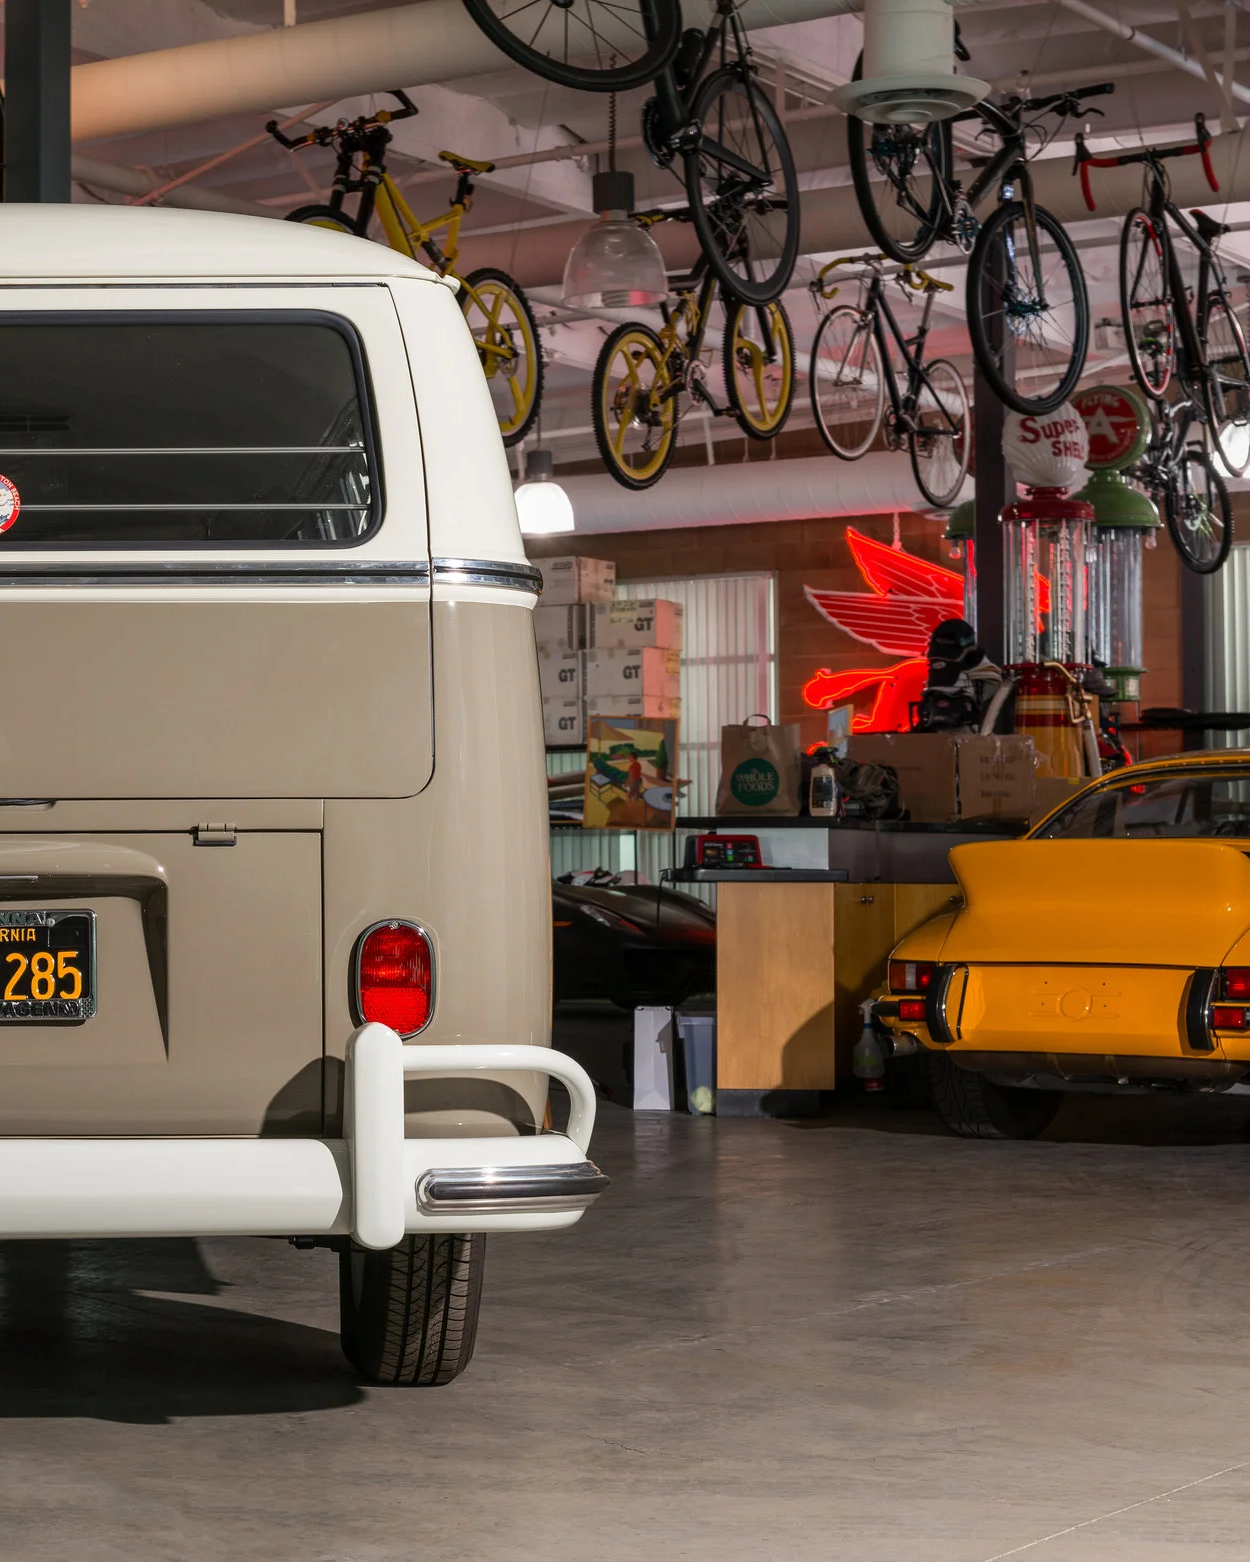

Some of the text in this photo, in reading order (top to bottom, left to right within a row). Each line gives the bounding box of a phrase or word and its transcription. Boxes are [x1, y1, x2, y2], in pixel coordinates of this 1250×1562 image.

[10, 487, 21, 510] BEACH
[634, 616, 654, 632] GT
[558, 667, 577, 683] GT
[622, 665, 641, 680] GT
[558, 716, 577, 731] GT
[735, 769, 775, 782] WHOLE
[737, 781, 775, 792] FOODS
[3, 950, 83, 1000] 285
